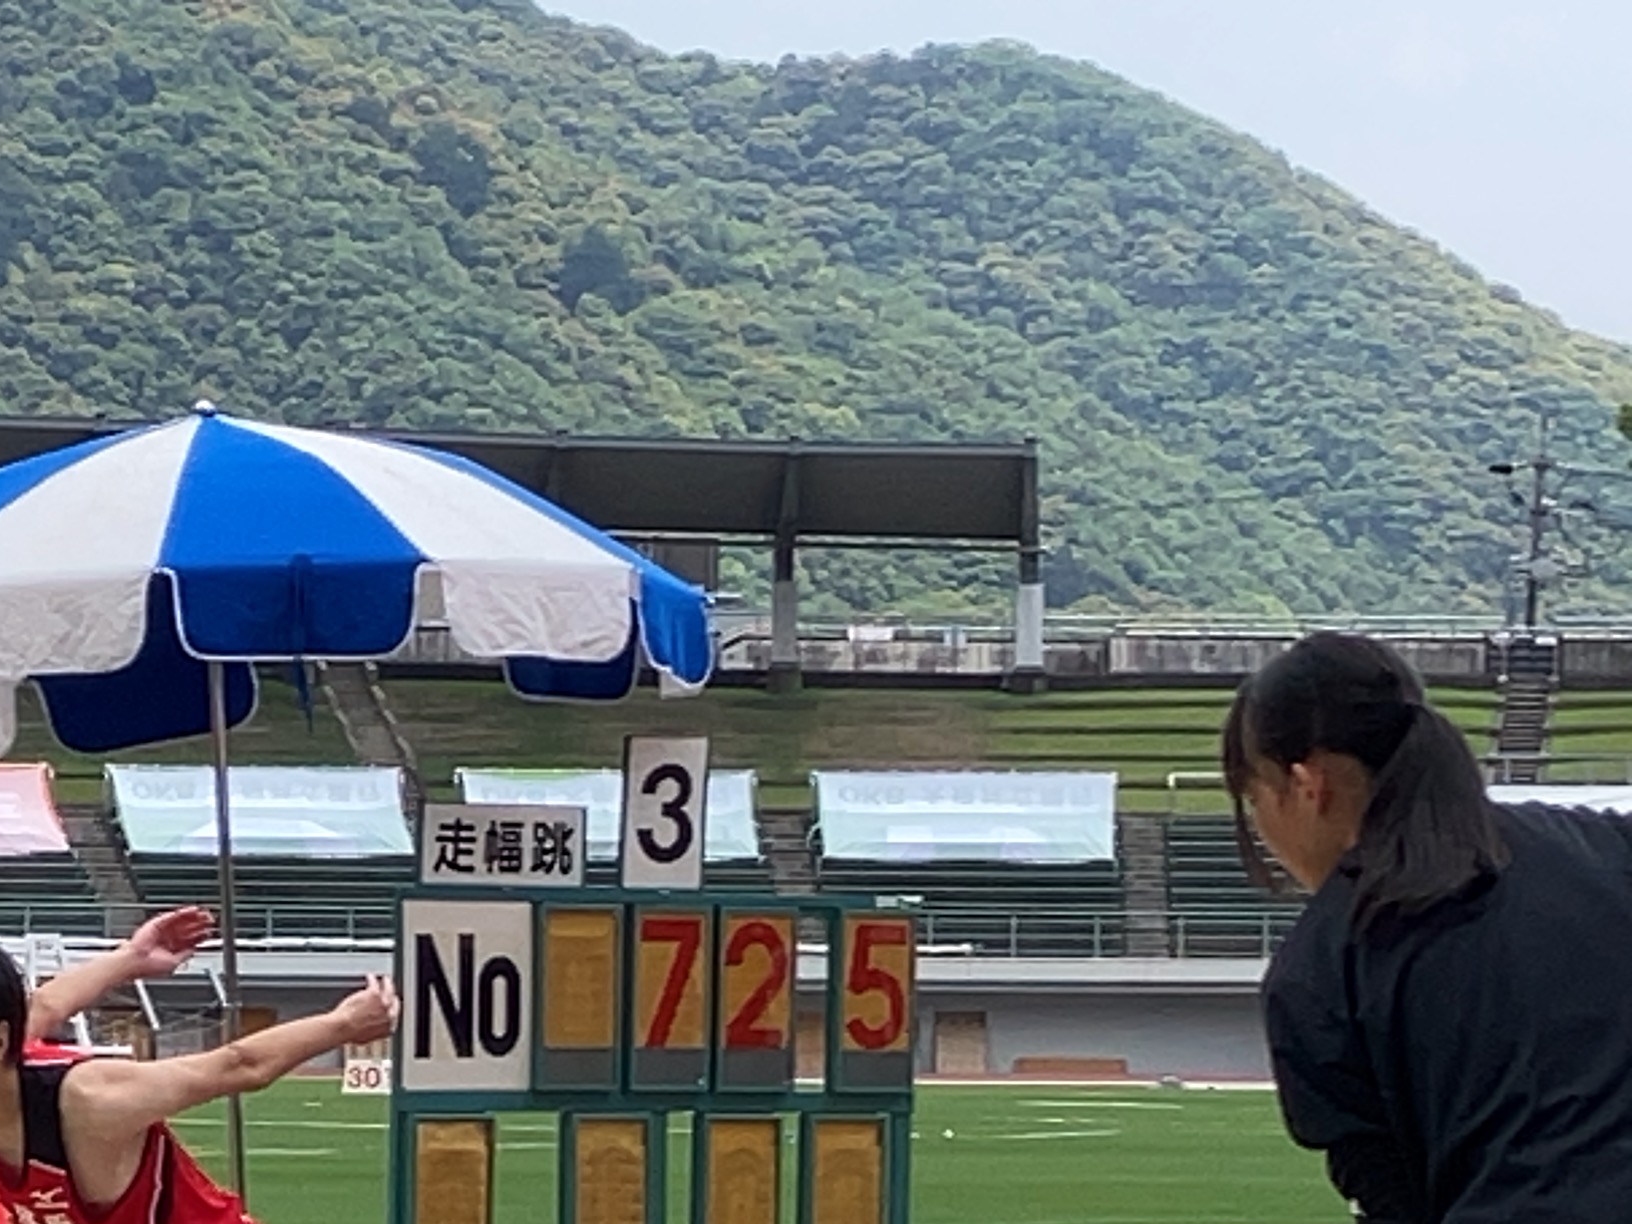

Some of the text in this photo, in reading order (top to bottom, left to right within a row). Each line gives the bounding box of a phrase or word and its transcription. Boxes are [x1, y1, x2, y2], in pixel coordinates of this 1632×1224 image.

[433, 817, 575, 875] 走幅跳
[637, 763, 693, 864] 3
[413, 933, 522, 1059] No
[348, 1067, 381, 1089] 30
